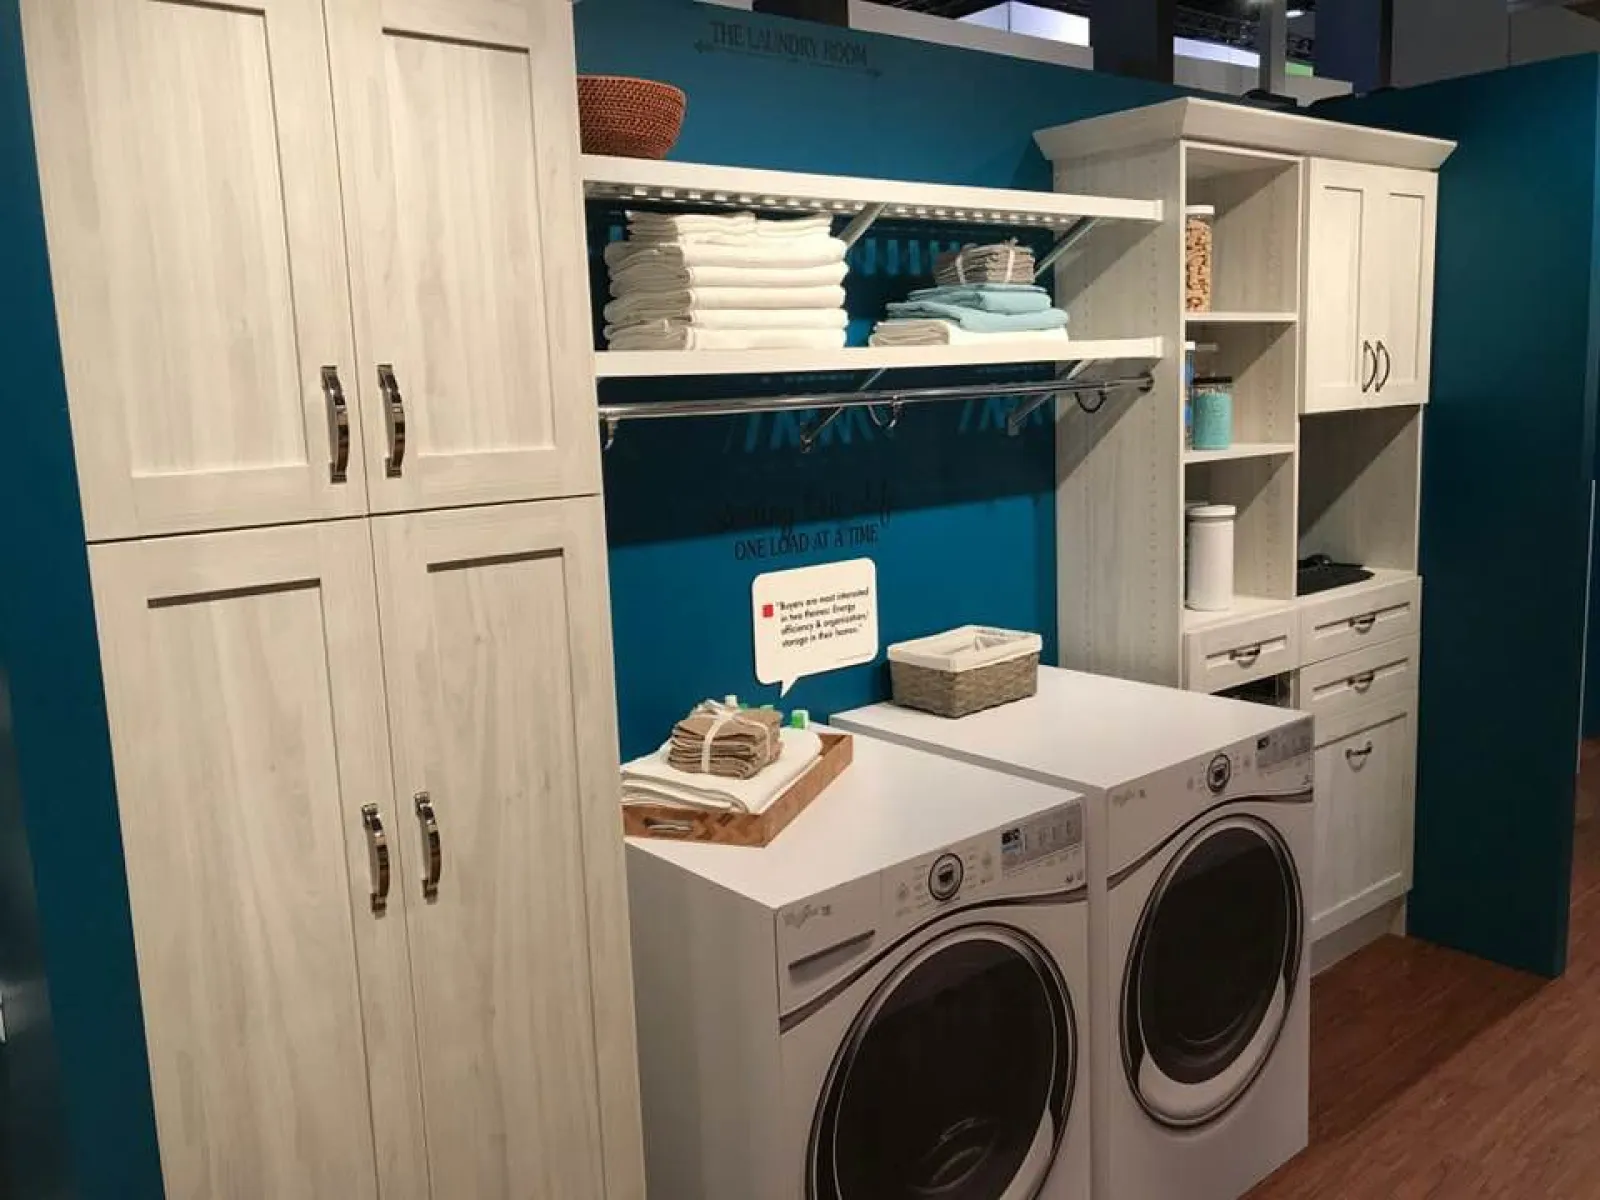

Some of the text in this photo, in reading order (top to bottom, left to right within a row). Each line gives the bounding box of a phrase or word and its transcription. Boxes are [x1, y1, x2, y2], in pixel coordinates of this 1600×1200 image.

[709, 21, 869, 67] THE LAUNDRY ROOM
[734, 523, 879, 561] ONE LOAD AT A TIME
